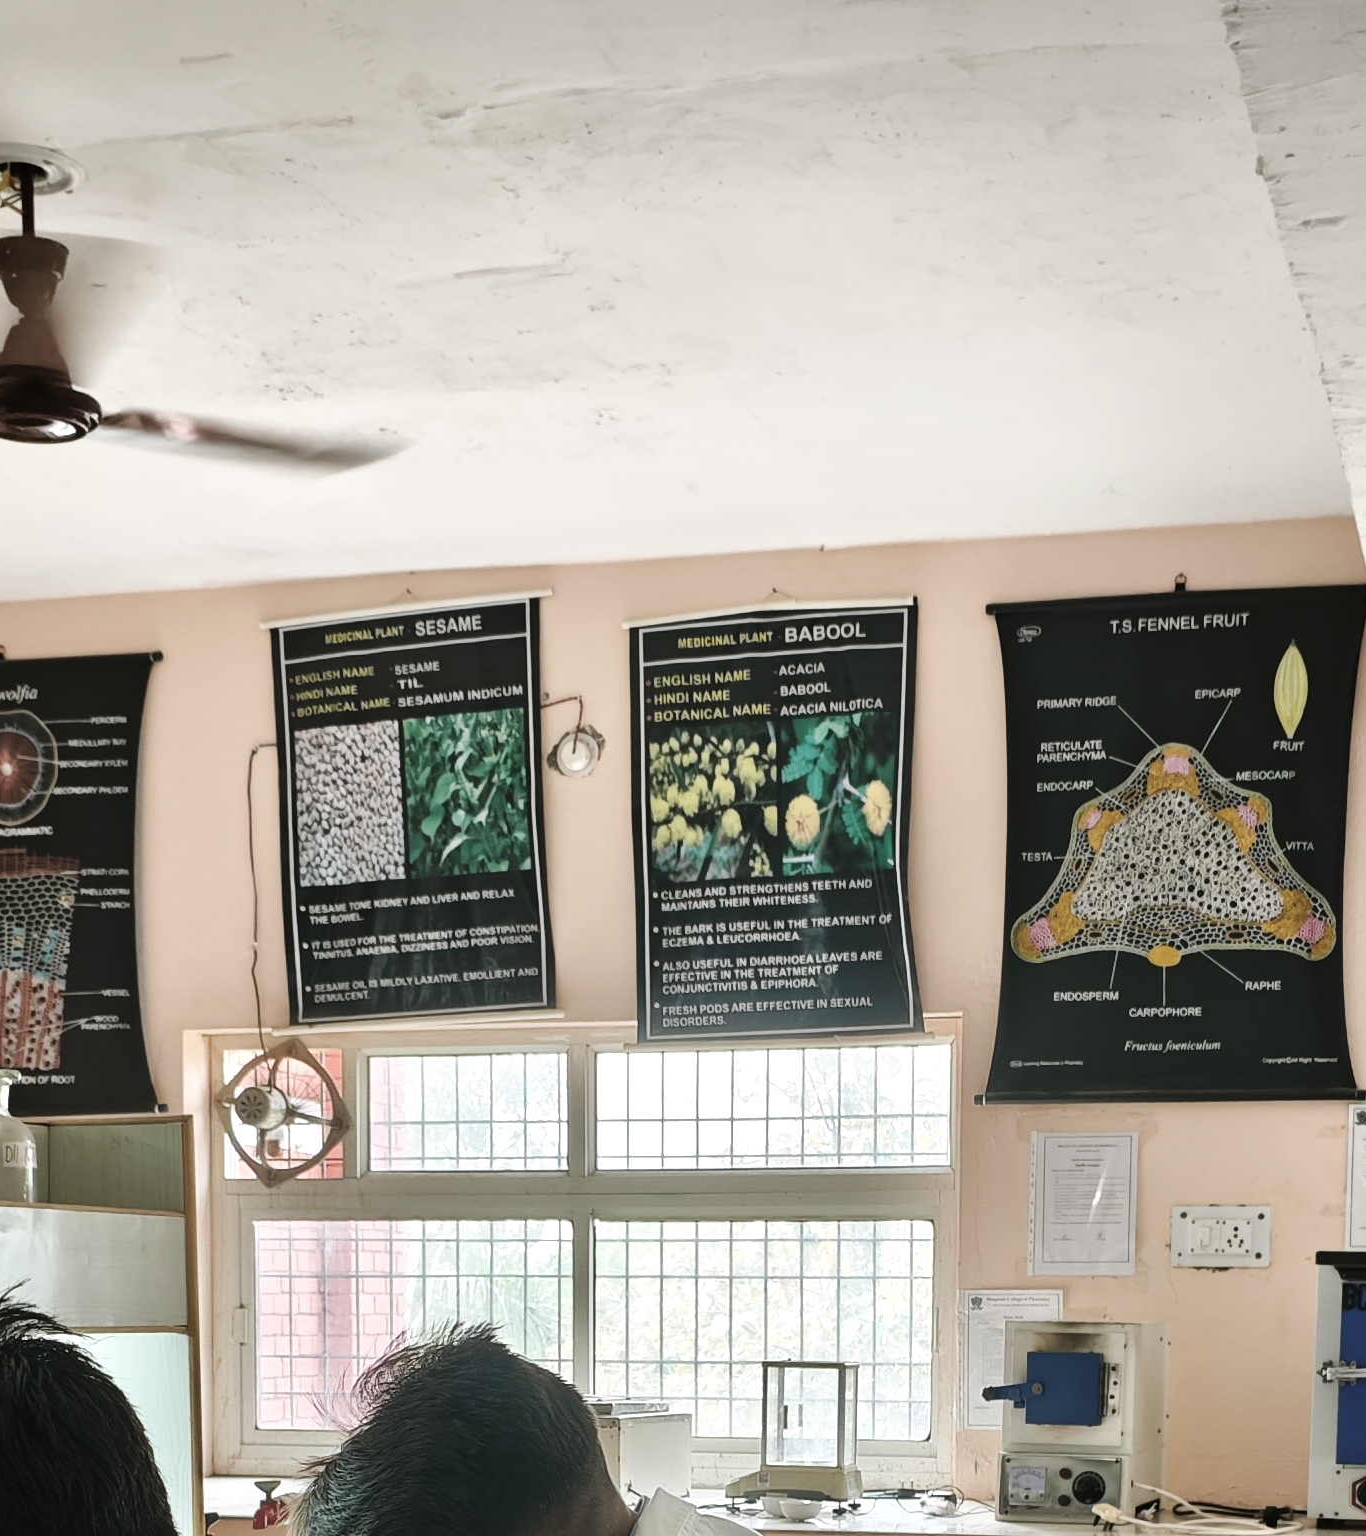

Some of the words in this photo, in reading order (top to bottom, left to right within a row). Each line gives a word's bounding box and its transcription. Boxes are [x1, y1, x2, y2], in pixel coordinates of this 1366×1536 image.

[325, 629, 374, 644] MEDICINAL
[375, 626, 404, 638] PLANT
[415, 615, 482, 636] SESAME
[1110, 620, 1135, 633] T.S.
[1138, 616, 1199, 631] FENNEL
[1204, 613, 1249, 628] FRUIT
[678, 634, 736, 648] MEDICINAL
[740, 631, 773, 644] PLANT
[785, 622, 866, 643] BABOOL
[295, 670, 340, 685] ENGLISH
[343, 666, 374, 678] NAME
[395, 661, 440, 675] SESAME
[654, 673, 710, 688] ENGLISH
[715, 669, 750, 683] NAME
[779, 662, 825, 676] ACACIA
[296, 689, 323, 701] HINDI
[326, 685, 358, 696] NAME
[397, 678, 423, 689] TIL
[654, 692, 689, 705] HINDI
[693, 690, 730, 703] NAME
[780, 682, 831, 696] BABOOL
[1195, 688, 1241, 699] EPICARP
[297, 702, 358, 717] BOTANICAL
[361, 698, 390, 710] NAME
[398, 691, 464, 707] SESAMUM
[468, 685, 523, 700] INDICUM
[1037, 698, 1082, 709] PRIMARY
[1085, 696, 1116, 707] RIDGE
[654, 707, 730, 722] BOTANICAL
[733, 704, 771, 716] NAME
[780, 702, 826, 716] ACACIA
[830, 698, 883, 712] NILOTICA
[1041, 740, 1102, 752] RETICULATE
[1273, 741, 1304, 751] FRUIT
[1037, 750, 1106, 763] PARENCHYMA
[1236, 770, 1295, 781] MESOCARP
[1037, 780, 1093, 792] ENDOCARP
[1286, 841, 1314, 850] VITTA
[1022, 852, 1052, 861] TESTA
[661, 888, 702, 900] CLEANS
[704, 886, 726, 896] AND
[729, 882, 809, 895] STRENGTHENS
[812, 880, 846, 891] TEETH
[849, 879, 872, 889] AND
[661, 899, 716, 911] MAINTAINS
[719, 897, 750, 907] THEIR
[663, 961, 690, 971] ALSO
[693, 959, 733, 969] USEFUL
[736, 958, 747, 967] IN
[750, 954, 814, 966] DIARRHOEA
[816, 952, 857, 963] LEAVES
[860, 951, 882, 961] ARE
[663, 971, 717, 983] EFFECTIVE
[721, 970, 731, 979] IN
[734, 968, 754, 979] THE
[758, 966, 822, 977] TREATMENT
[825, 964, 839, 975] OF
[663, 981, 748, 994] CONJUNCTIVITIS
[750, 980, 758, 990] &
[1245, 981, 1281, 991] RAPHE
[1054, 991, 1119, 1001] ENDOSPERM
[663, 1005, 697, 1016] FRESH
[700, 1003, 729, 1014] PODS
[731, 1003, 754, 1012] ARE
[756, 1000, 814, 1011] EFFECTIVE
[817, 999, 827, 1008] IN
[830, 997, 873, 1007] SEXUAL
[1129, 1007, 1201, 1017] CARPOPHORE
[663, 1016, 727, 1027] DISORDERS.
[1124, 1041, 1162, 1051] Fructus
[1163, 1040, 1220, 1053] foeniculum
[51, 1075, 75, 1084] ROOT
